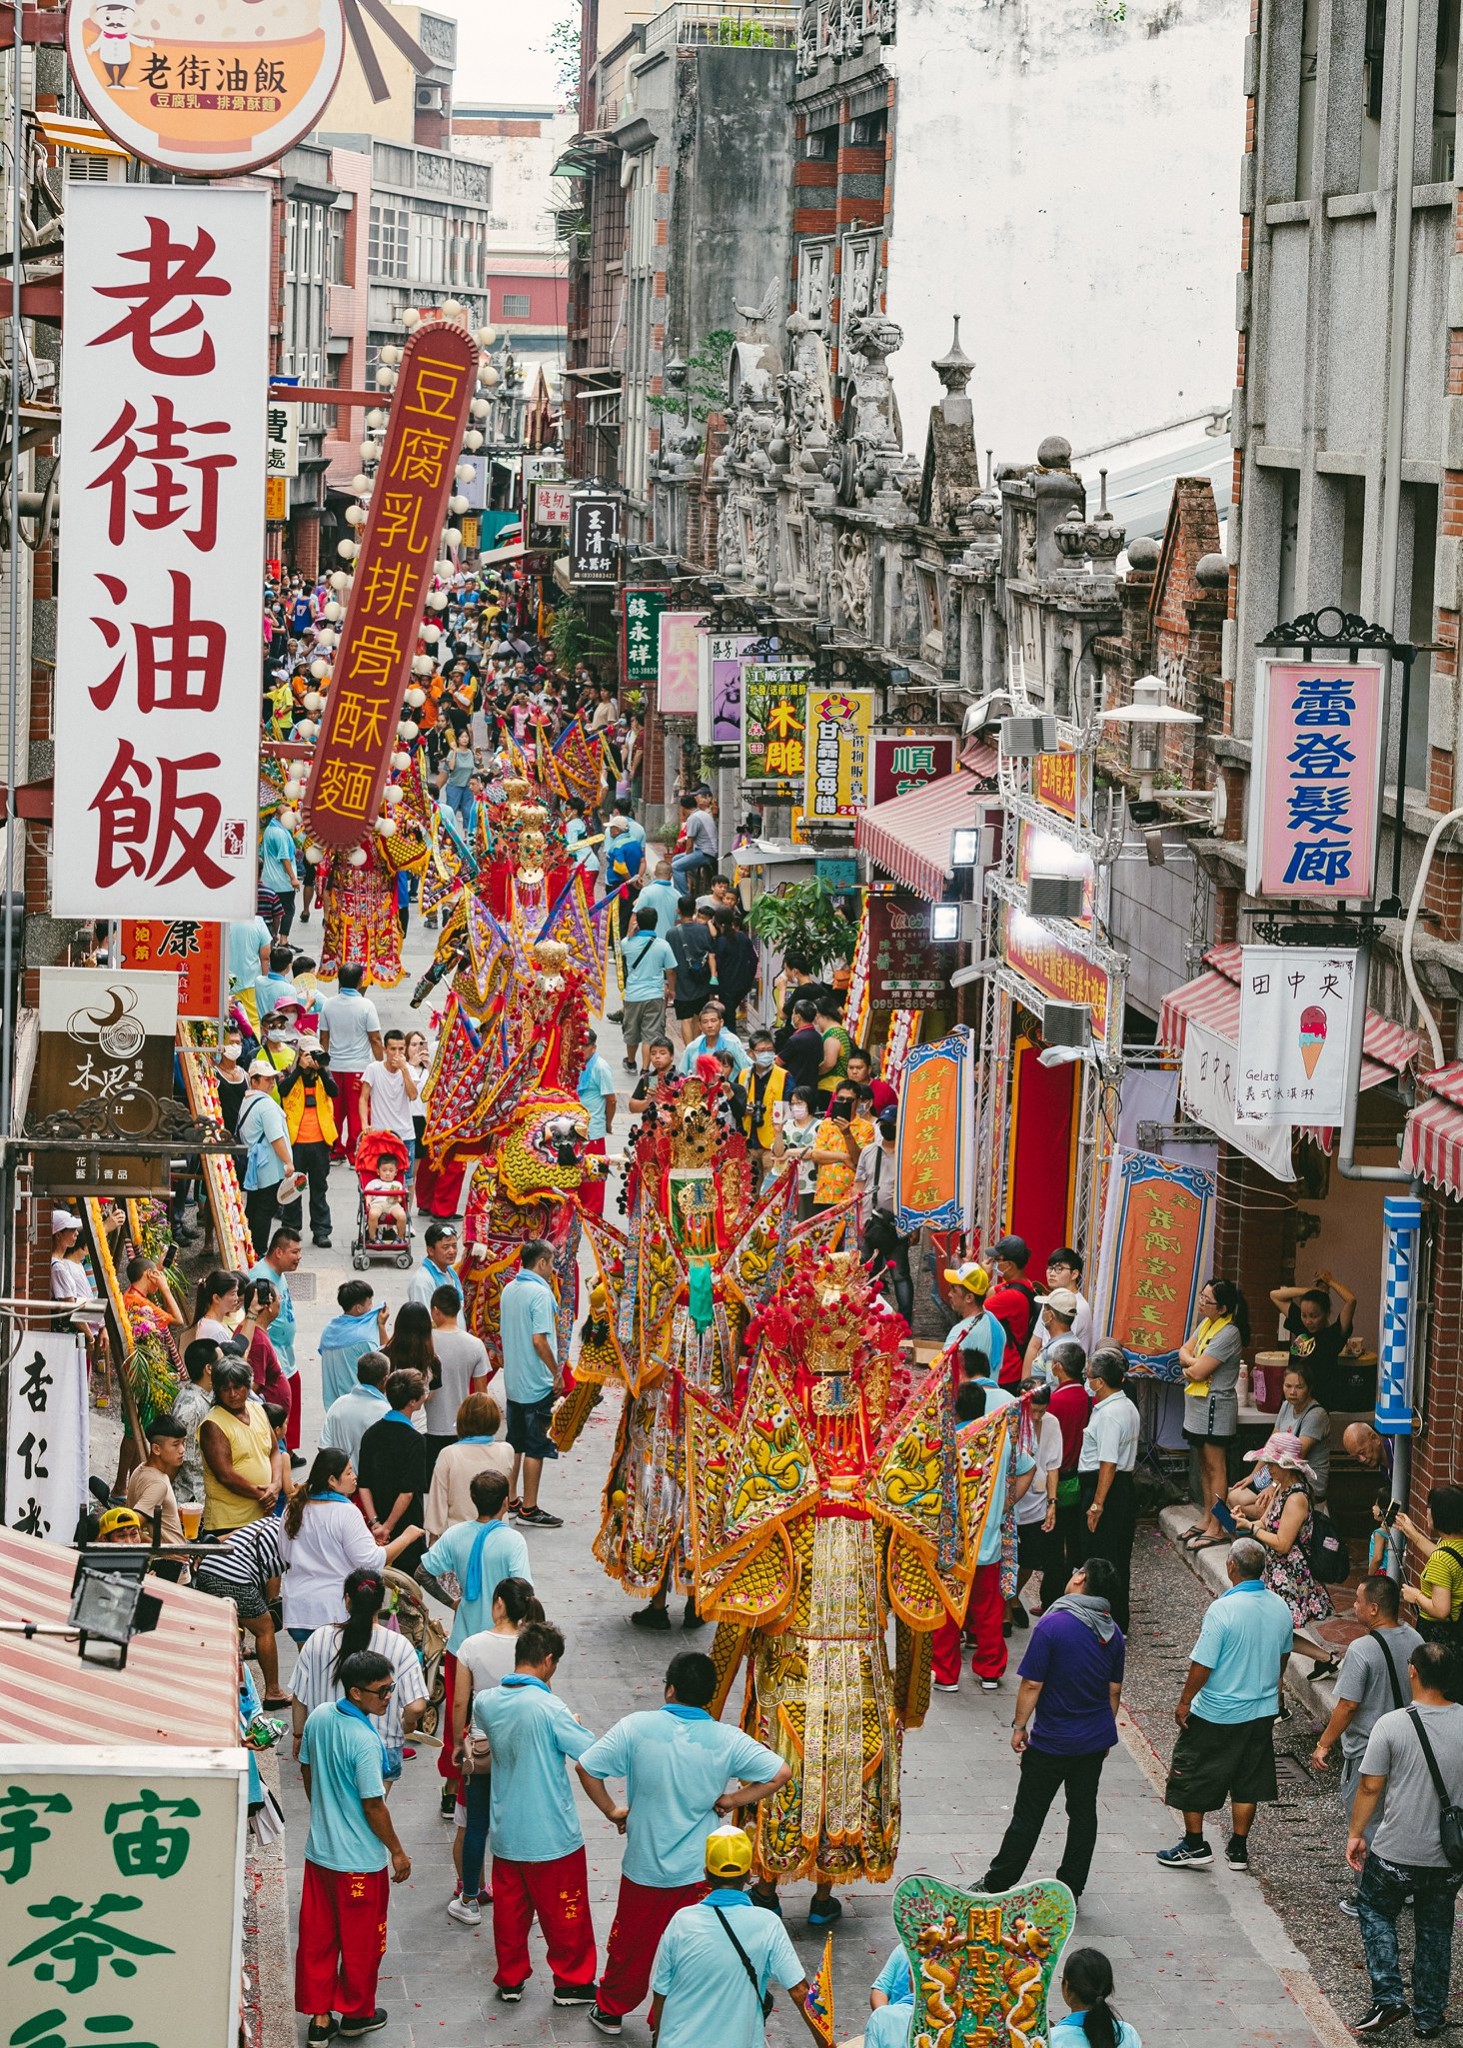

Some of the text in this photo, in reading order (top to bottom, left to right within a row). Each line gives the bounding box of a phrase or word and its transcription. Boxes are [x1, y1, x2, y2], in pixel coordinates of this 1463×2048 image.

[140, 53, 288, 93] 老街油飯
[85, 216, 237, 889] 老街油飯
[585, 510, 606, 554] 玉清
[315, 356, 465, 820] 豆腐乳排骨酥麵
[628, 598, 651, 666] 蘇永祥
[765, 699, 806, 776] 木雕
[1282, 679, 1357, 886] 蕾登髮廊
[1253, 971, 1343, 1000] 田中央
[1246, 1069, 1279, 1082] Gelato
[1246, 1086, 1315, 1101] 義式冰淇淋
